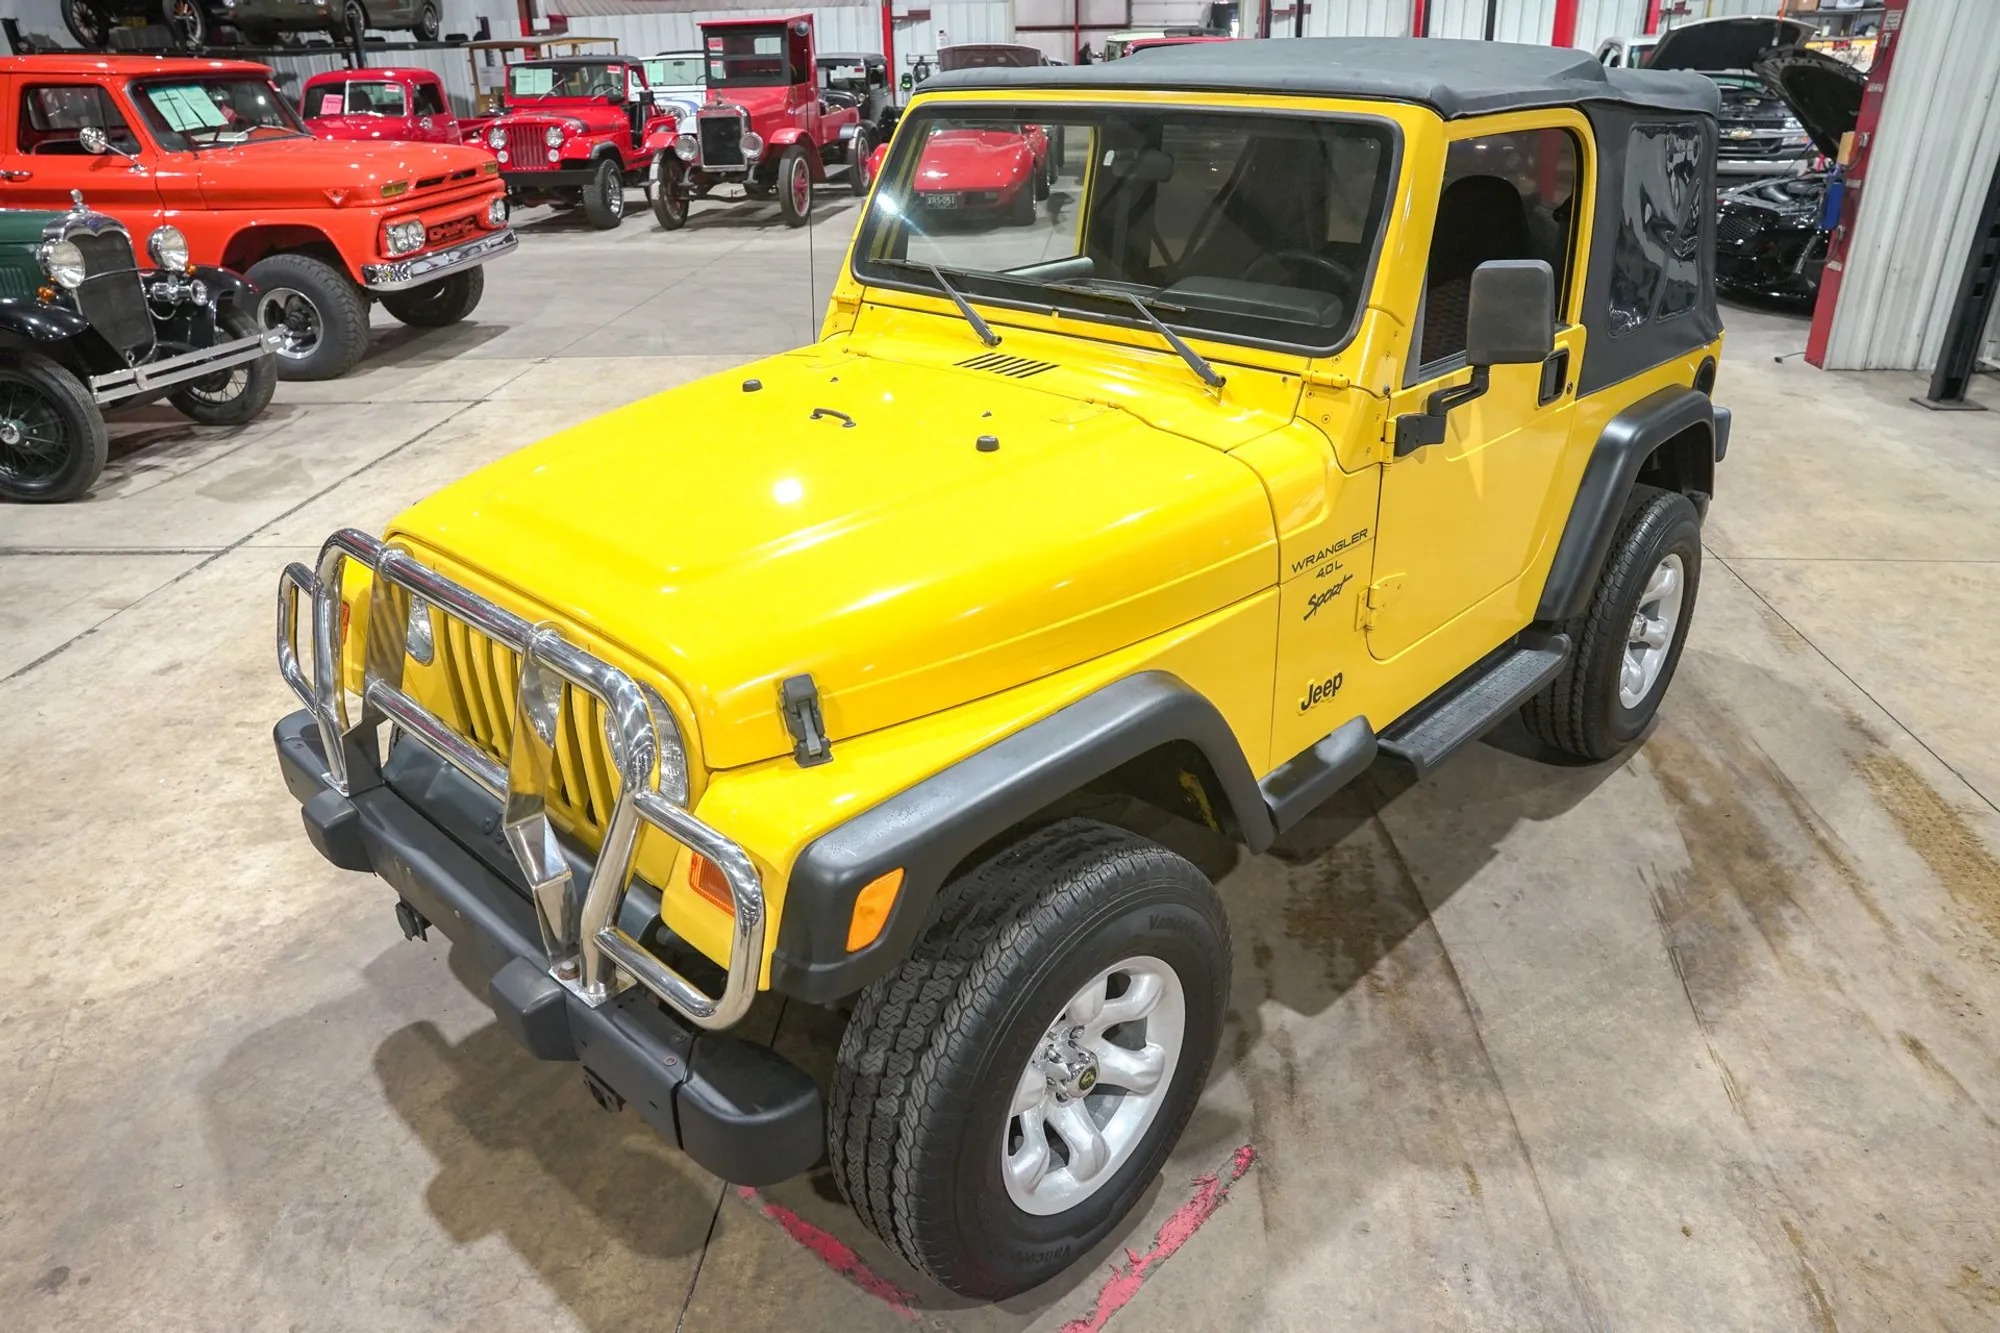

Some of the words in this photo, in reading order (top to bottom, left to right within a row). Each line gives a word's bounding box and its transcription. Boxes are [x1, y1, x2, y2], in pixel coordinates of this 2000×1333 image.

[1291, 528, 1369, 573] WRANGLER
[1303, 573, 1353, 621] Sport
[1300, 671, 1343, 712] Jeep
